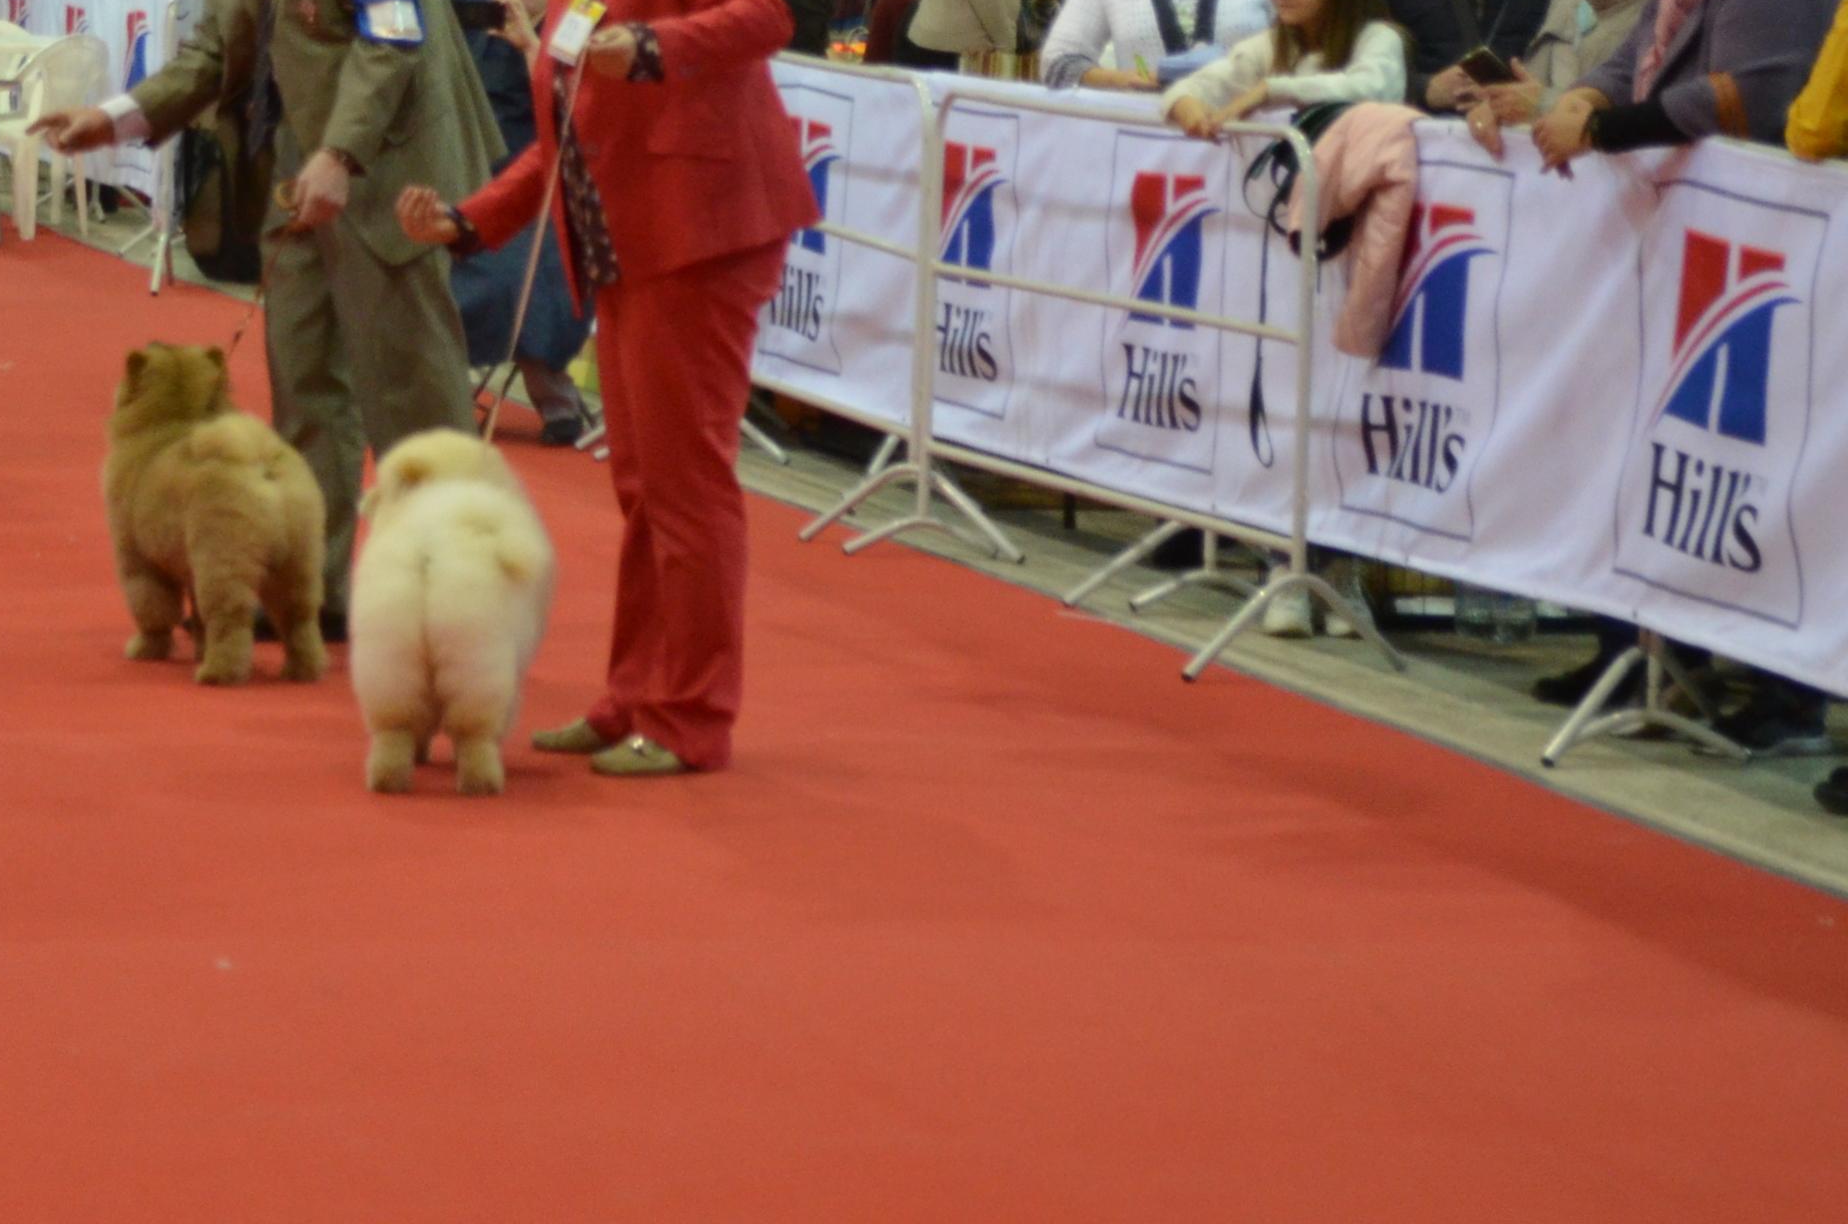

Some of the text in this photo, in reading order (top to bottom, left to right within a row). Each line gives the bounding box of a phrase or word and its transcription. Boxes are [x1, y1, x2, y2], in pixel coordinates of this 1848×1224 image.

[1117, 342, 1202, 433] Hill's
[1360, 392, 1467, 495] Hill's
[1641, 441, 1764, 575] Hill's
